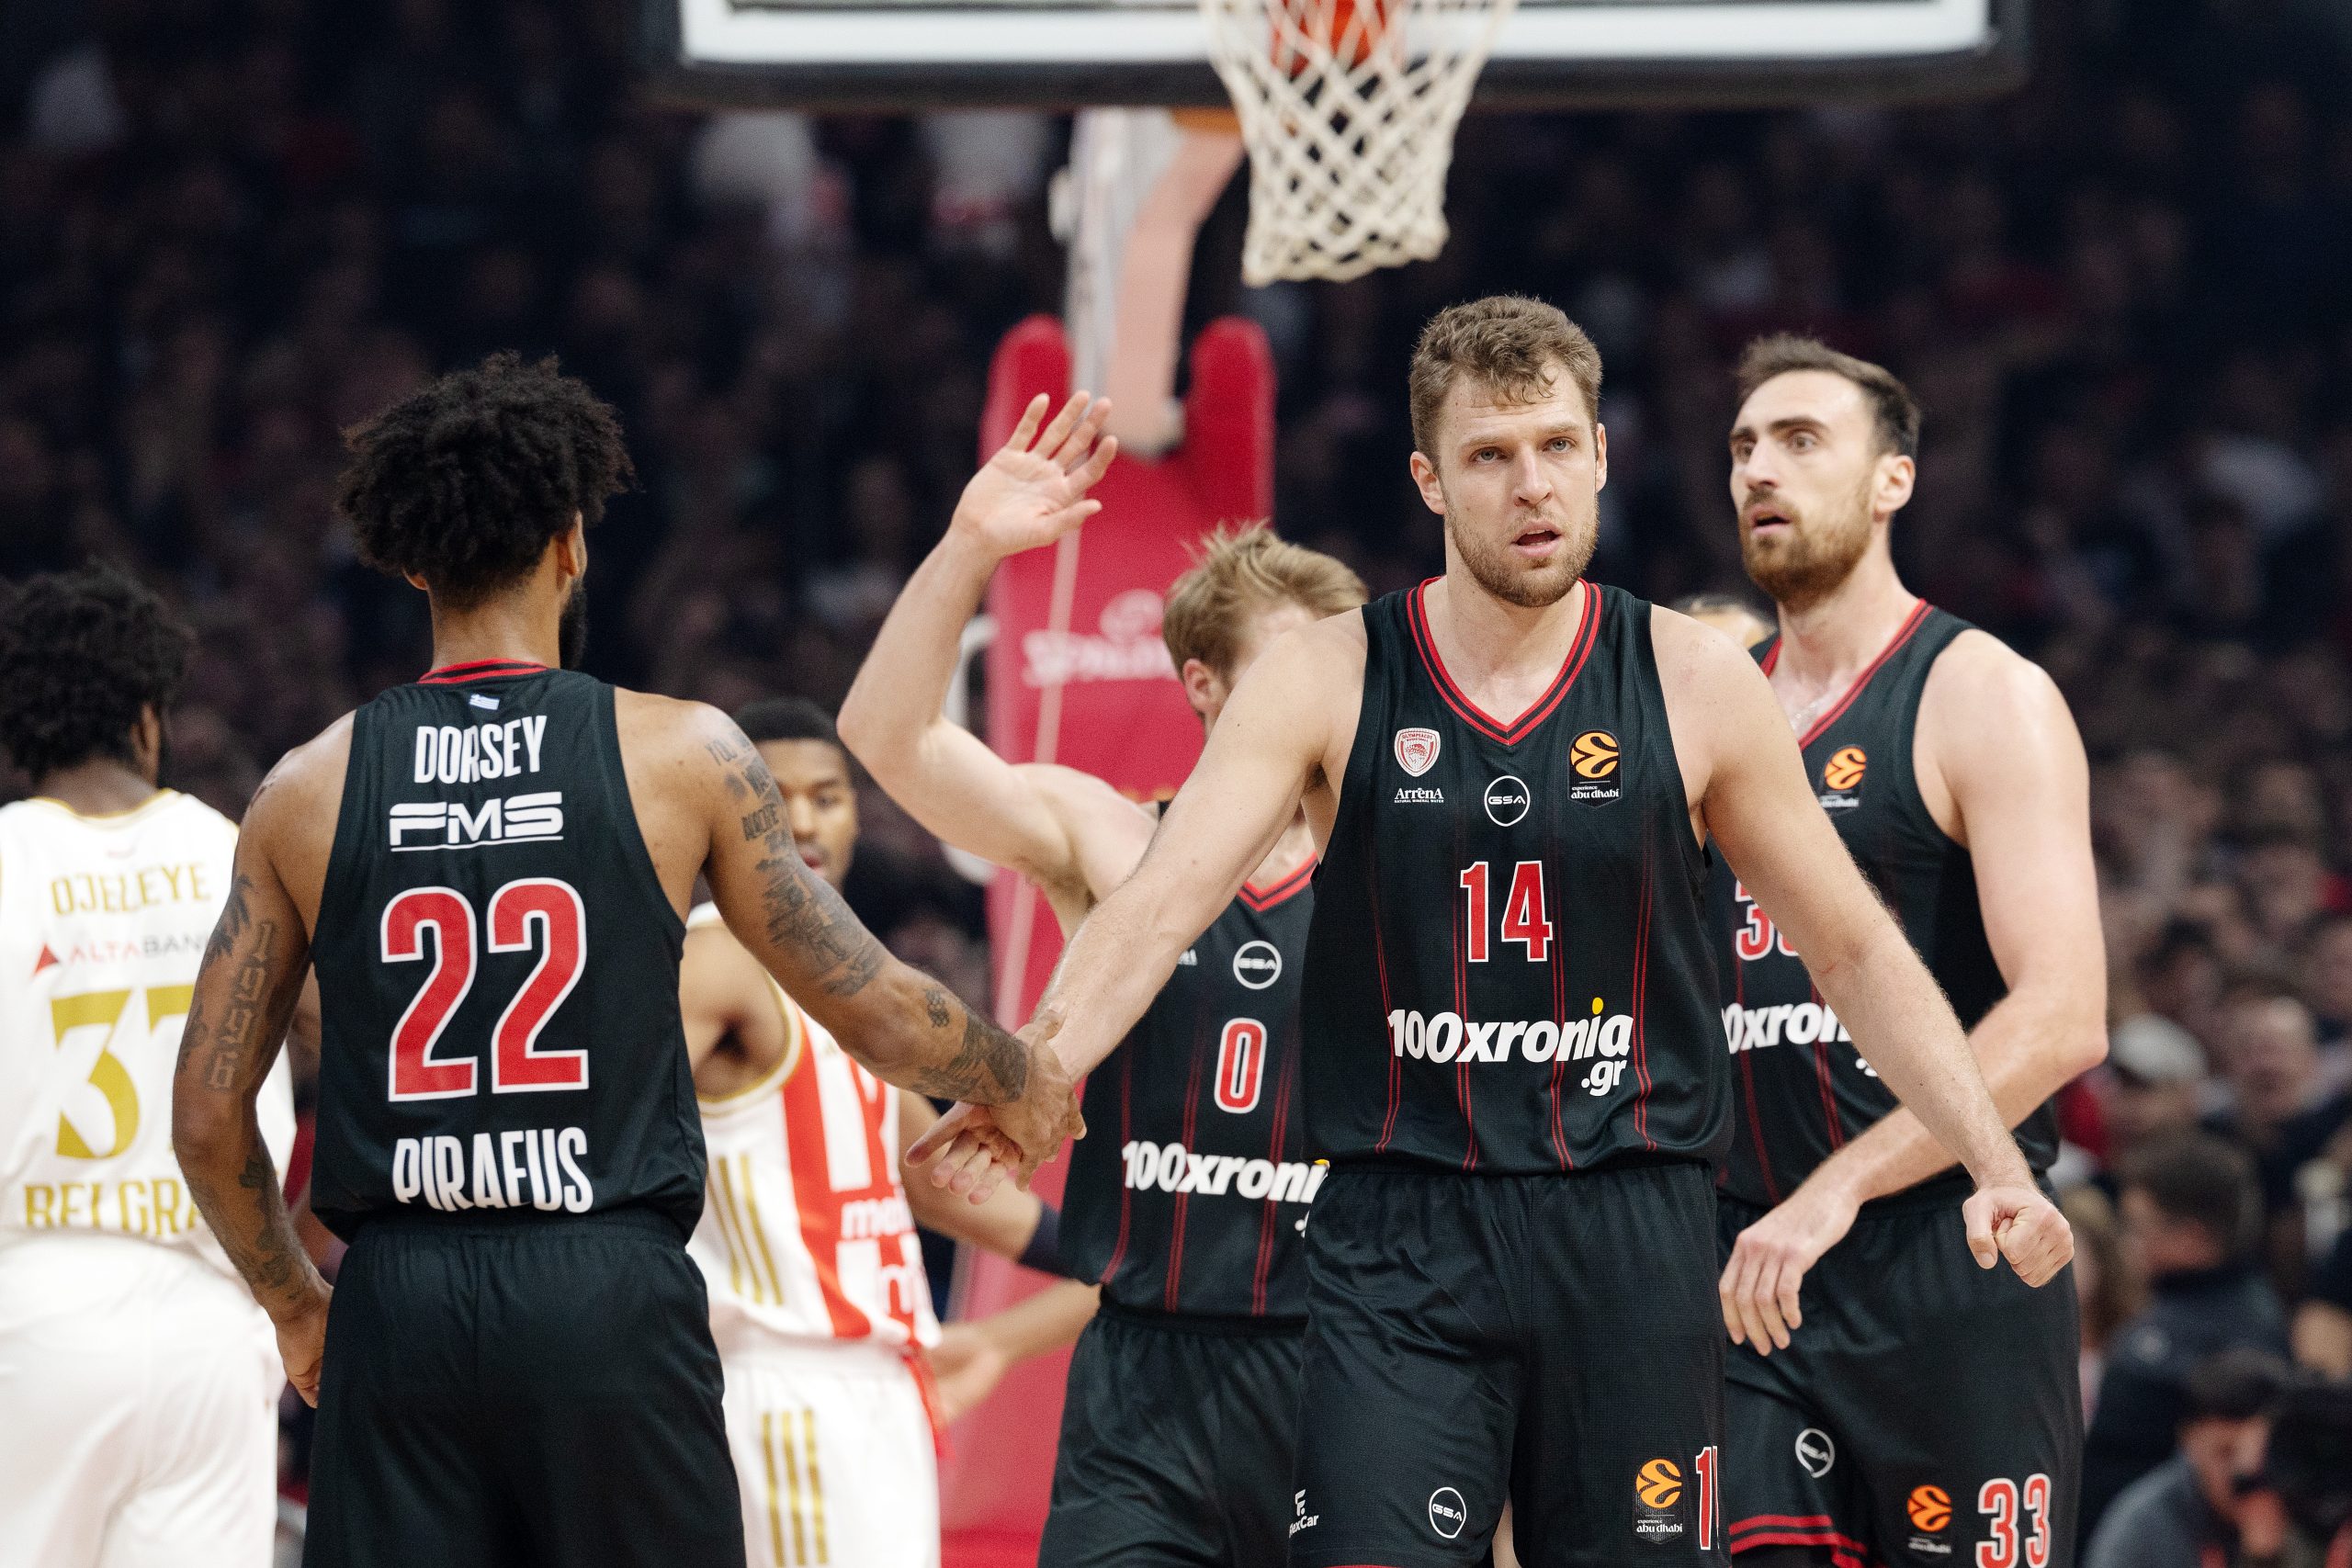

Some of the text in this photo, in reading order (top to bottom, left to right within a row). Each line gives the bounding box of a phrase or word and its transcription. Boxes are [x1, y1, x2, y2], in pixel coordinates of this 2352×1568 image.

[413, 715, 548, 784] DORSEY
[389, 790, 564, 847] FMS
[1487, 794, 1526, 807] GSA
[1571, 788, 1620, 799] abu dhabi
[51, 863, 210, 916] OJELEYE
[1459, 860, 1554, 963] 14
[1734, 879, 1799, 961] 3
[70, 931, 208, 964] ALTABAN
[380, 876, 590, 1103] 22
[1386, 997, 1634, 1064] 100xronia
[1213, 1017, 1269, 1114] 0
[1580, 1057, 1628, 1097] .gr
[392, 1126, 594, 1213] PIRAEUS
[1432, 1503, 1463, 1522] GSA
[1636, 1523, 1683, 1533] abu dhabi
[1695, 1445, 1720, 1551] 1
[1975, 1472, 2052, 1568] 33
